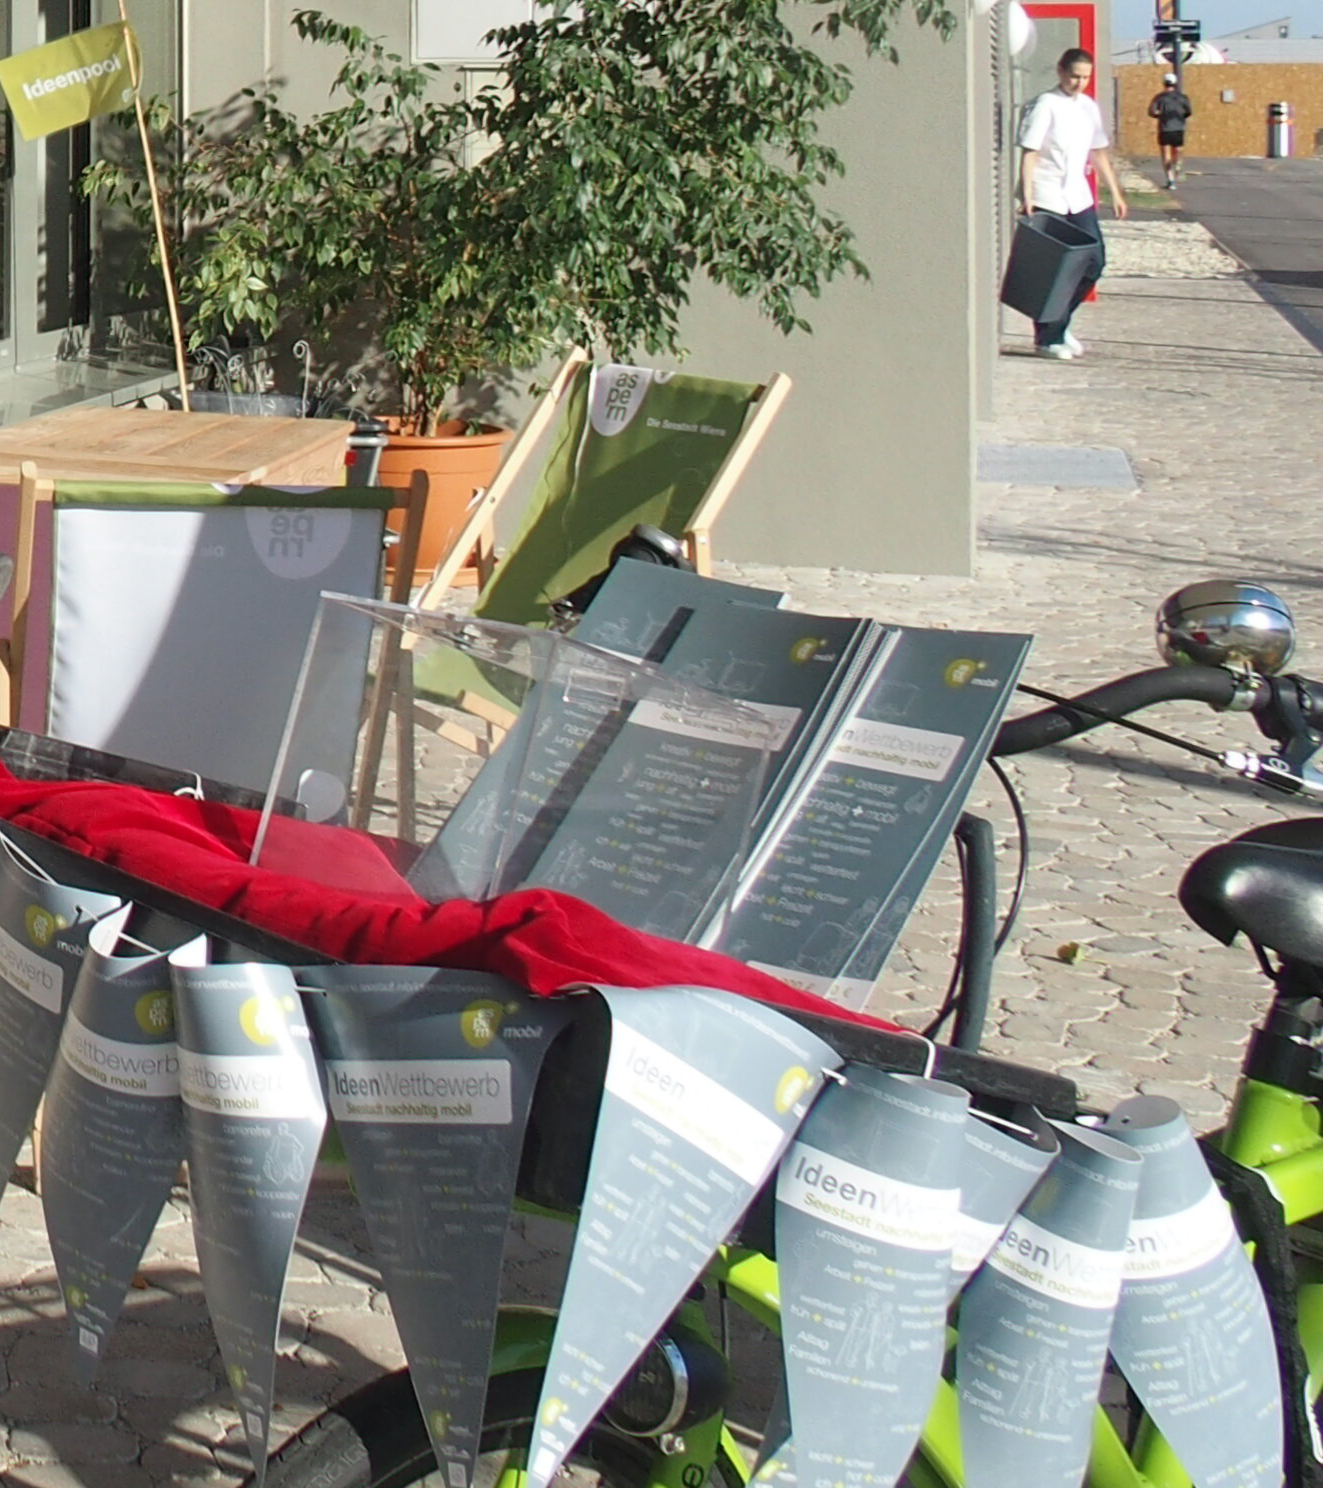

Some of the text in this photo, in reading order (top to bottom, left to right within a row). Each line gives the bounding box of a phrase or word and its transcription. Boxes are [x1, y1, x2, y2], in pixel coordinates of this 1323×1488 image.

[22, 53, 122, 101] Ideenpool
[971, 677, 1000, 688] mobil
[910, 758, 940, 770] mobil
[57, 940, 84, 957] mob
[503, 1025, 544, 1038] mobil
[110, 1074, 147, 1090] mobil
[334, 1072, 500, 1098] IdeenWettbewerb
[223, 1096, 259, 1110] mobil
[385, 1103, 439, 1119] nachhaltig
[441, 1104, 472, 1116] mobil
[804, 1191, 872, 1229] Seestadt
[815, 1228, 878, 1256] umsteigen
